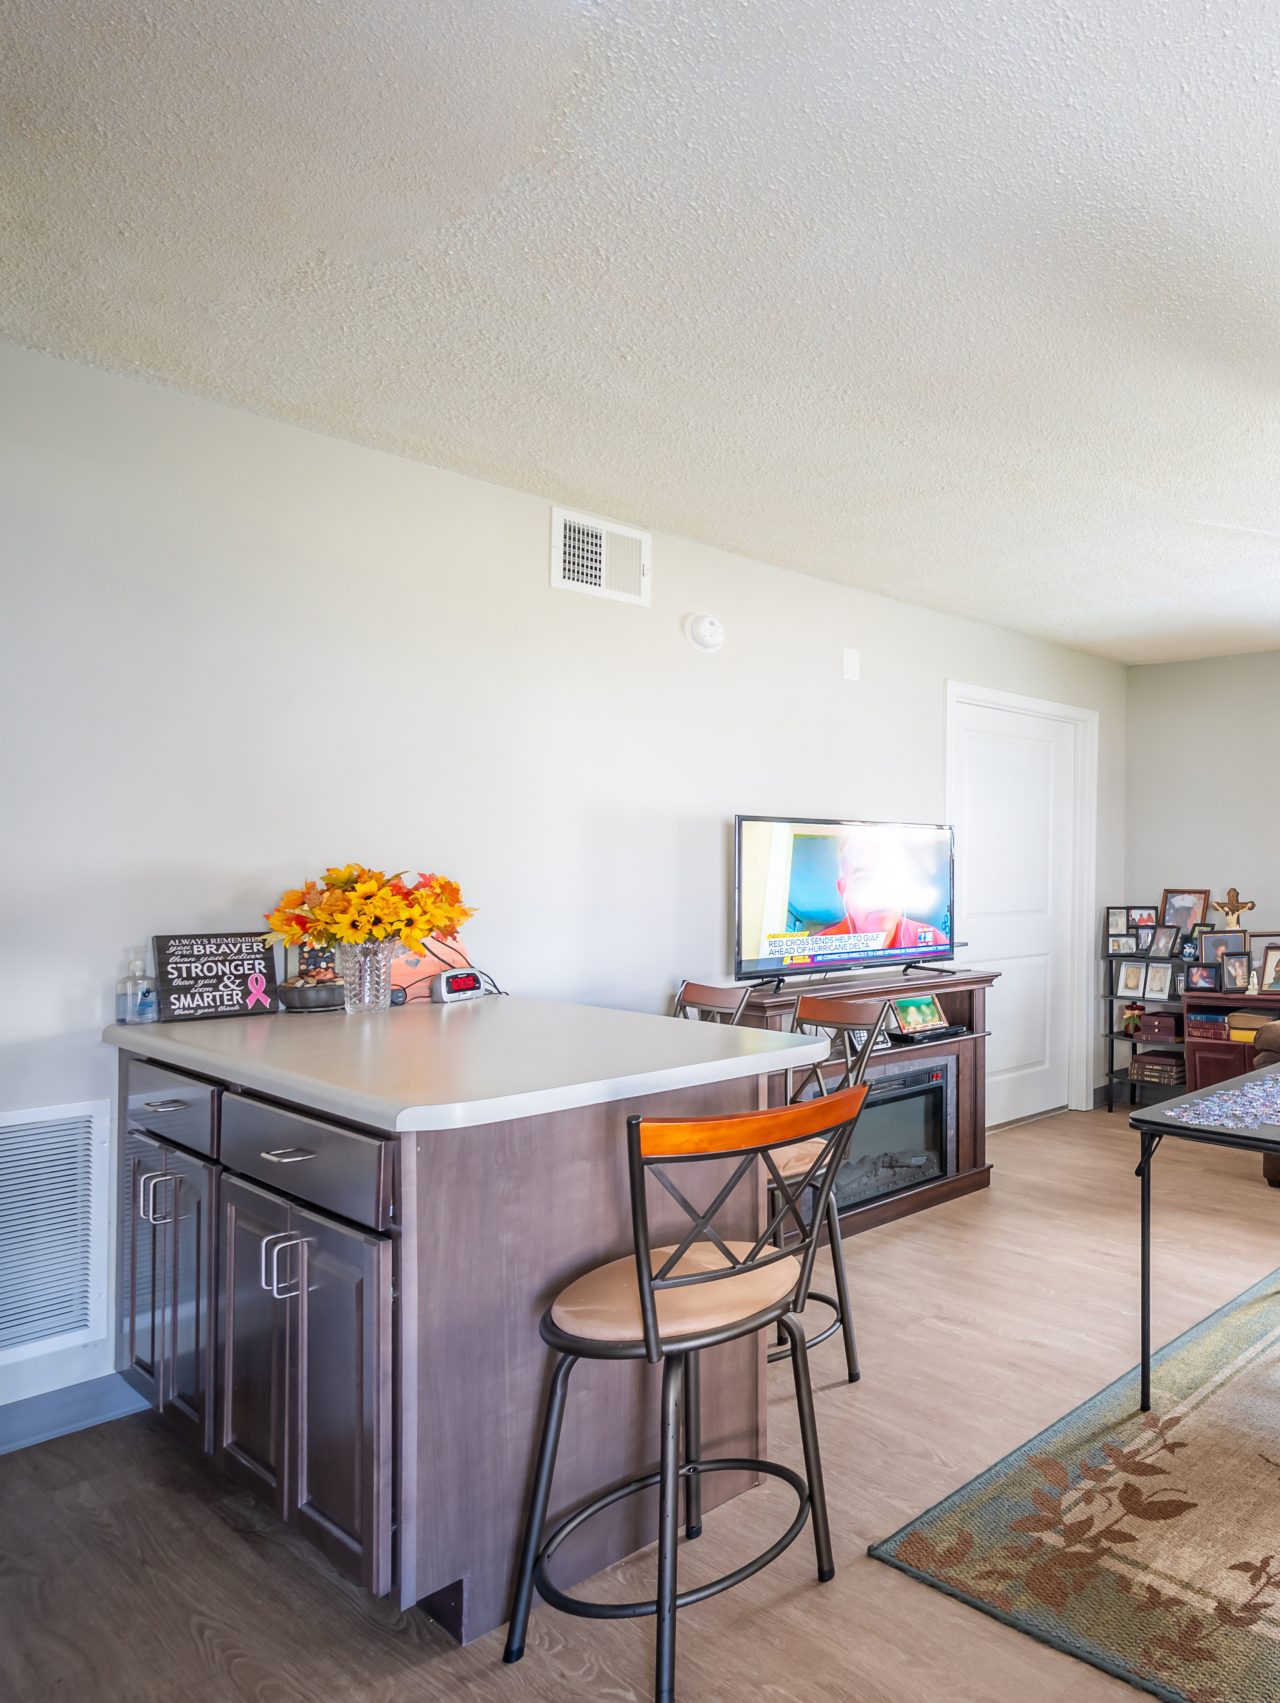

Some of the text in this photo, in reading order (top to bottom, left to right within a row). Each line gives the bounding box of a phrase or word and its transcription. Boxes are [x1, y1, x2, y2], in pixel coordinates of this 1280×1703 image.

[169, 938, 209, 946] ALWAYS
[769, 933, 881, 948] RED CROSS SENDS HELP TO GULF
[165, 945, 192, 954] you
[193, 942, 265, 955] BRAVER
[769, 941, 870, 956] AHEAD OF HURRICANE DELTA
[169, 955, 196, 963] than
[196, 956, 224, 964] you
[167, 960, 267, 978] STRONGER
[172, 978, 217, 988] than you
[218, 974, 244, 991] &
[170, 990, 244, 1009] SMARTER
[194, 1008, 215, 1016] you
